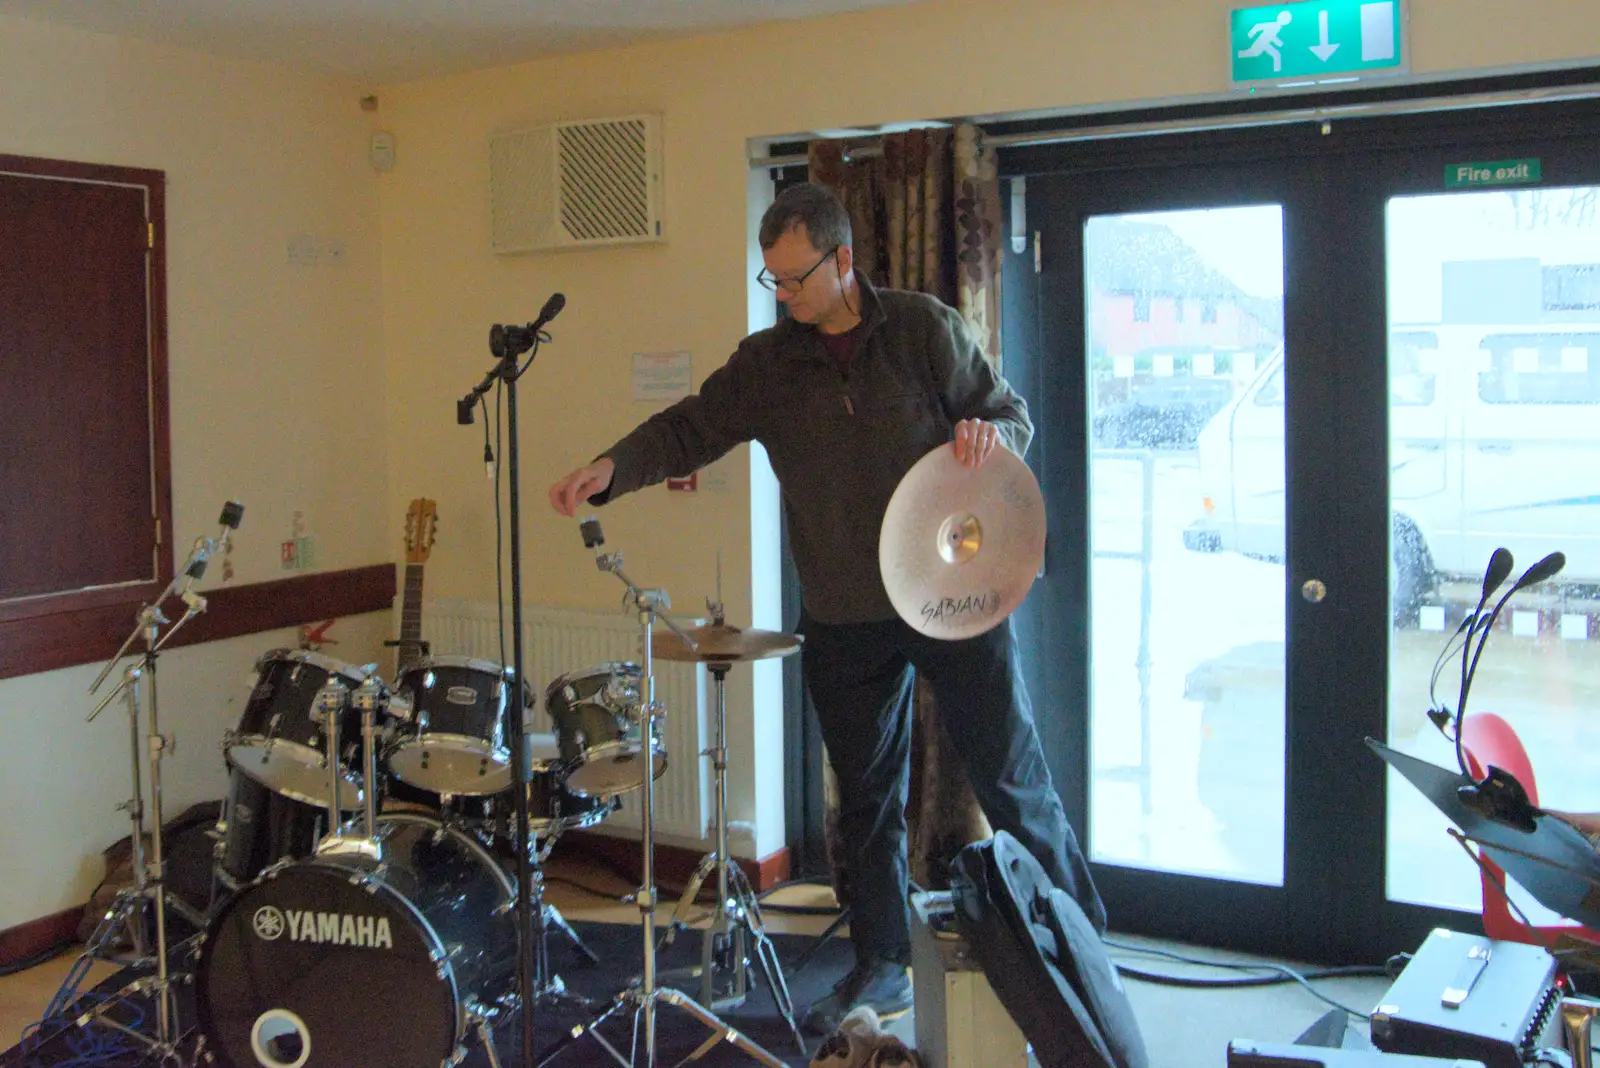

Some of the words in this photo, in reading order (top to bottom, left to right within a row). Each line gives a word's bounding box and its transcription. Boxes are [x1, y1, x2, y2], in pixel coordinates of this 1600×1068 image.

[1457, 167, 1490, 181] Fire
[1495, 163, 1528, 180] exit
[921, 594, 986, 628] SABIAN
[286, 909, 393, 949] YAMAHA
